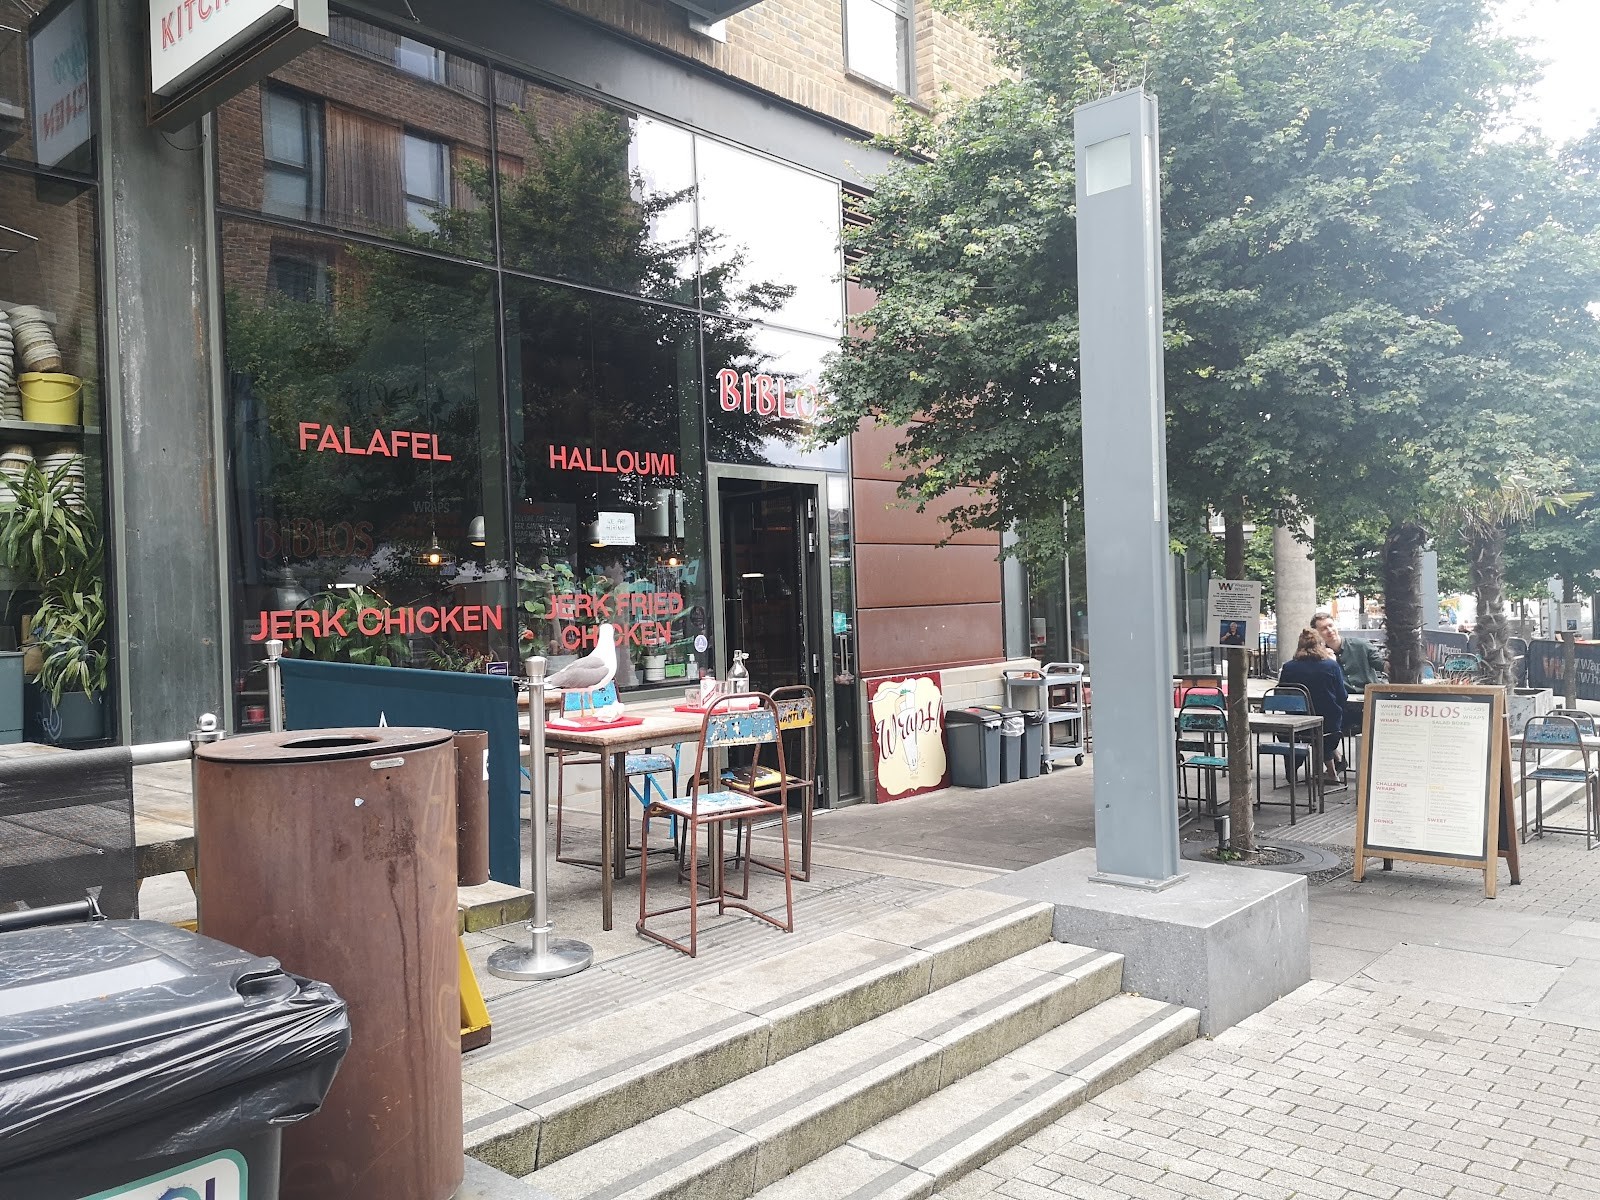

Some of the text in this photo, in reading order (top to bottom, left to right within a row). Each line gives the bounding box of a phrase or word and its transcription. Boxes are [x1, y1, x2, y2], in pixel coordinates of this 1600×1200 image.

[298, 421, 452, 462] FALAFEL
[549, 444, 676, 476] HALLOUMI
[412, 500, 450, 513] WRAPS
[254, 516, 374, 559] BIBLOS
[250, 604, 503, 641] JERK CHICKEN
[544, 592, 684, 621] JERK FRIED
[561, 621, 672, 650] CHCKEN
[1403, 704, 1461, 719] BIBLOS
[875, 697, 943, 761] Wraps!
